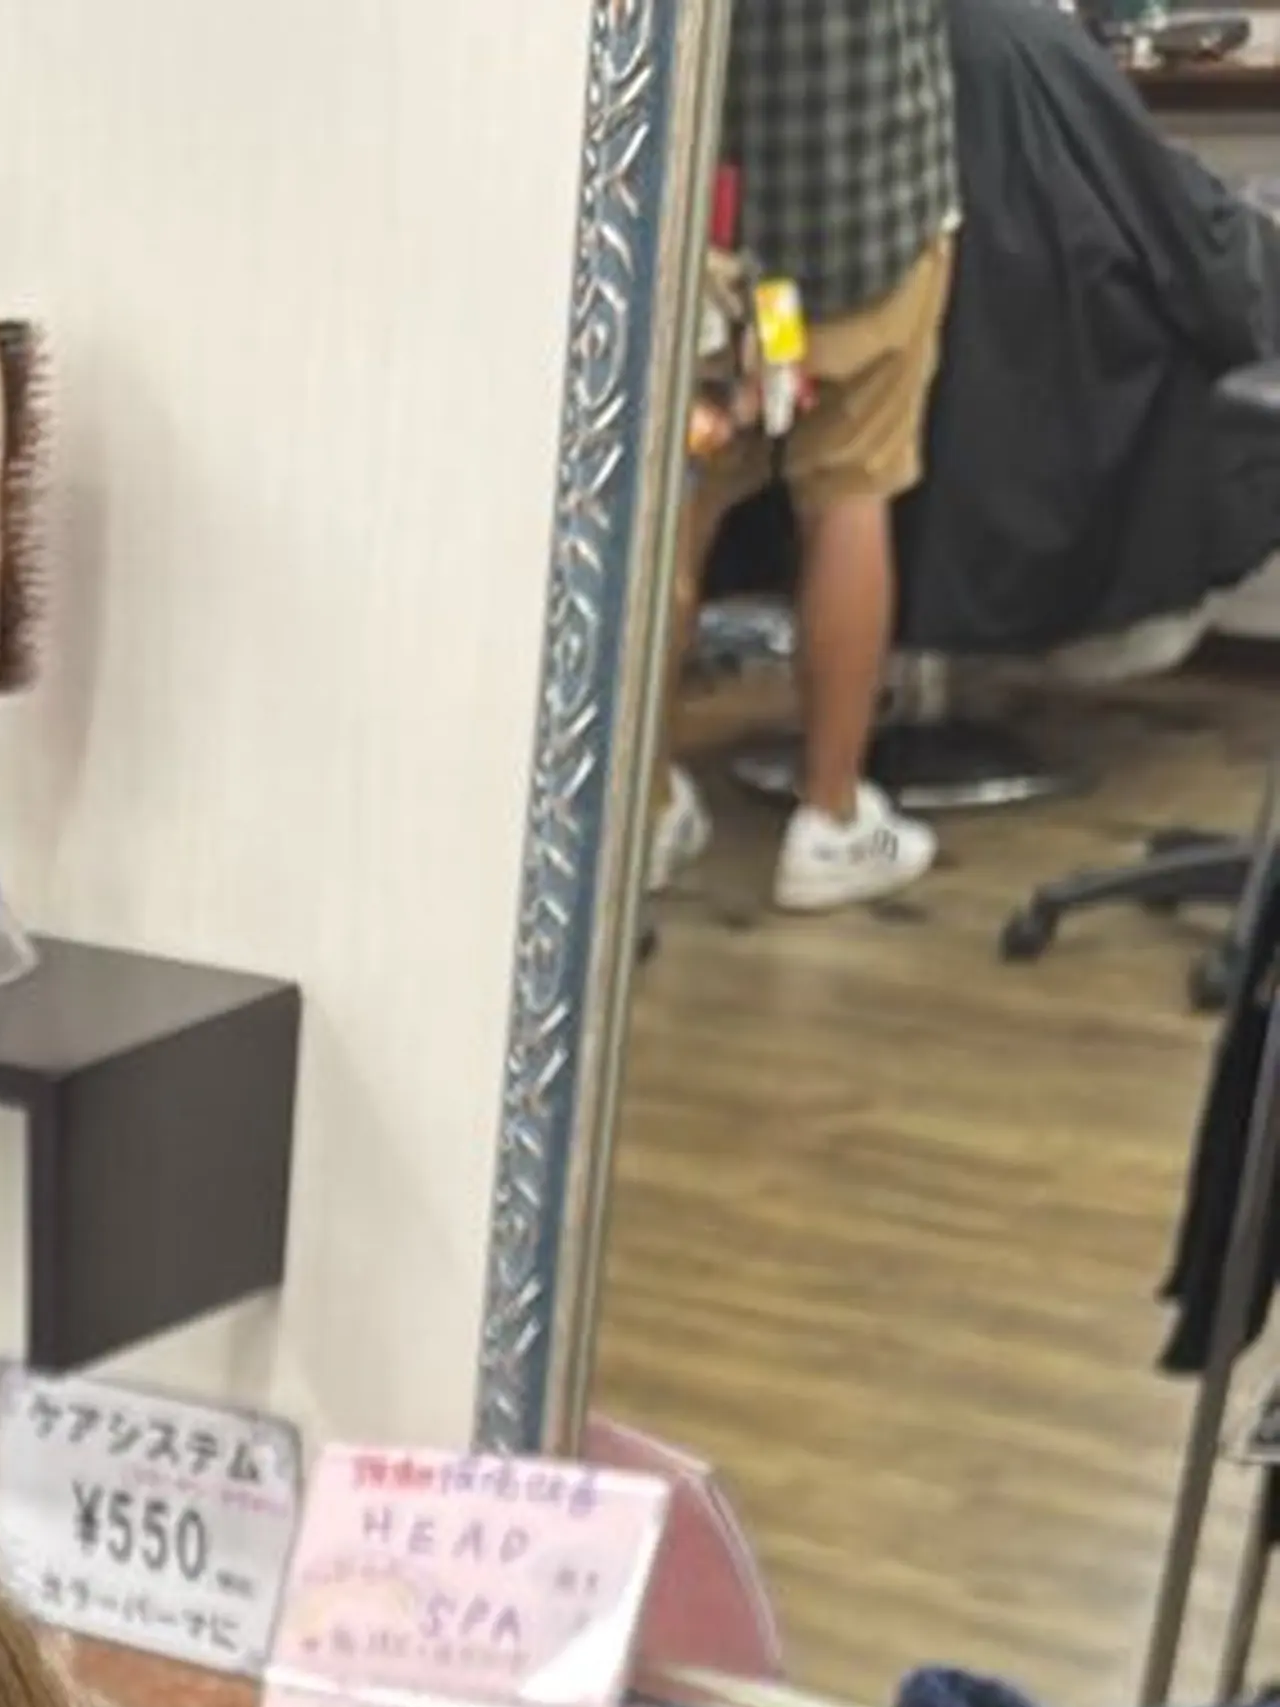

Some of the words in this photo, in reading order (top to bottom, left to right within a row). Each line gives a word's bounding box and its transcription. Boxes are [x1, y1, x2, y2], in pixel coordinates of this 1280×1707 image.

[28, 1394, 262, 1484] ケアシステム
[72, 1480, 208, 1582] ¥550
[361, 1505, 532, 1563] HEAD
[418, 1592, 522, 1644] SPA
